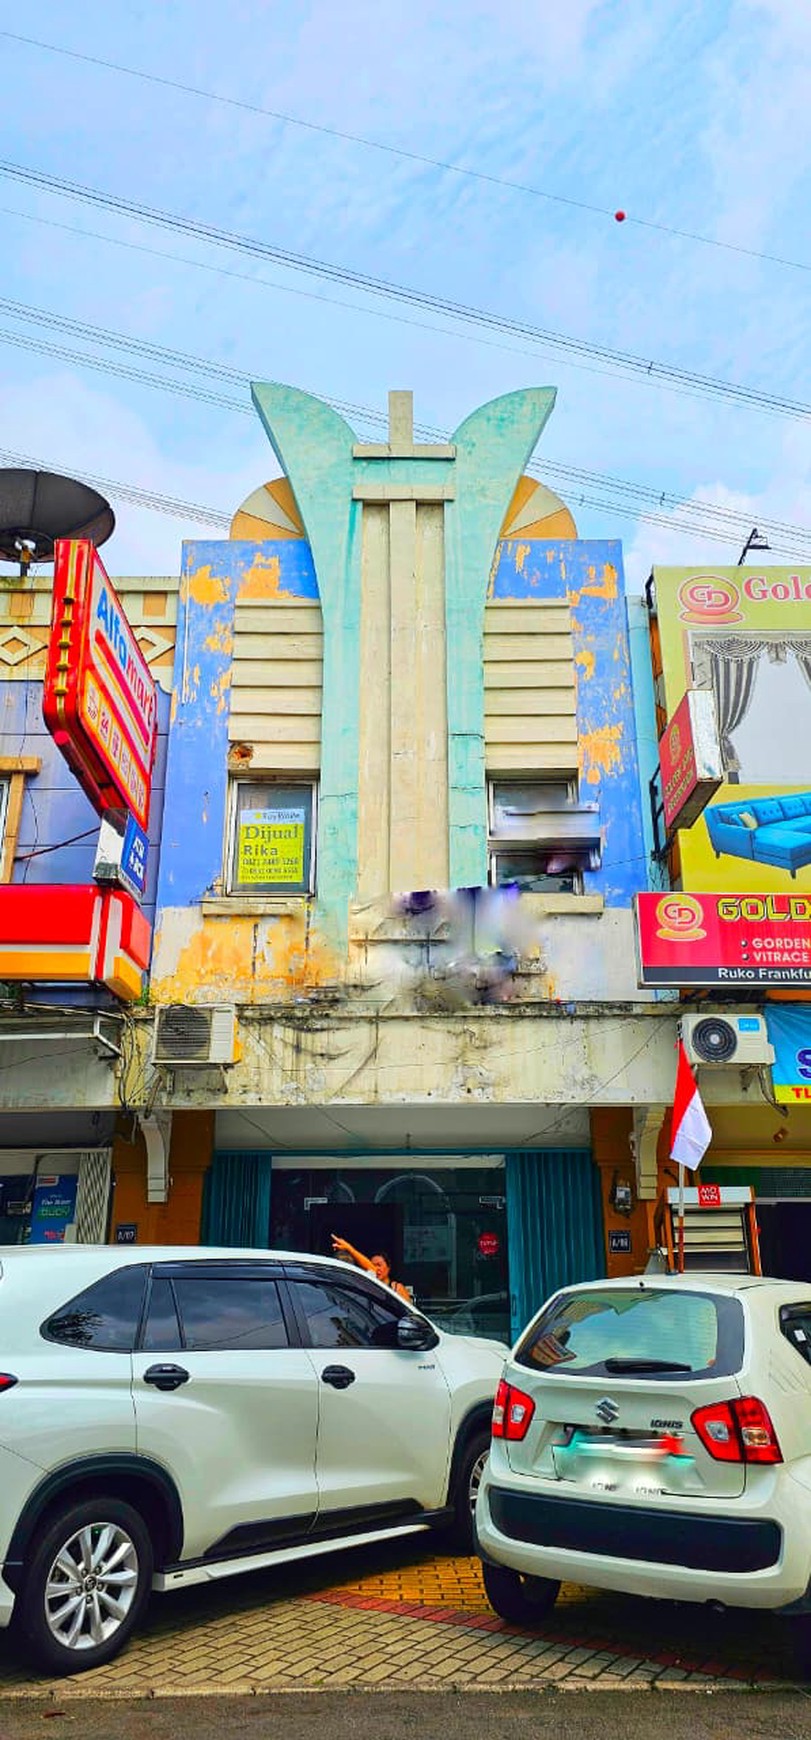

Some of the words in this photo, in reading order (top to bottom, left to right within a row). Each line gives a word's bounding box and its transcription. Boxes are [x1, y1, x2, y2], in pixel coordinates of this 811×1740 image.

[97, 587, 153, 727] Alfamart
[244, 824, 298, 843] Dijual
[244, 844, 278, 856] Rika
[753, 952, 810, 962] VITRACE
[718, 968, 755, 979] Ruko
[651, 1419, 683, 1429] IGNIS
